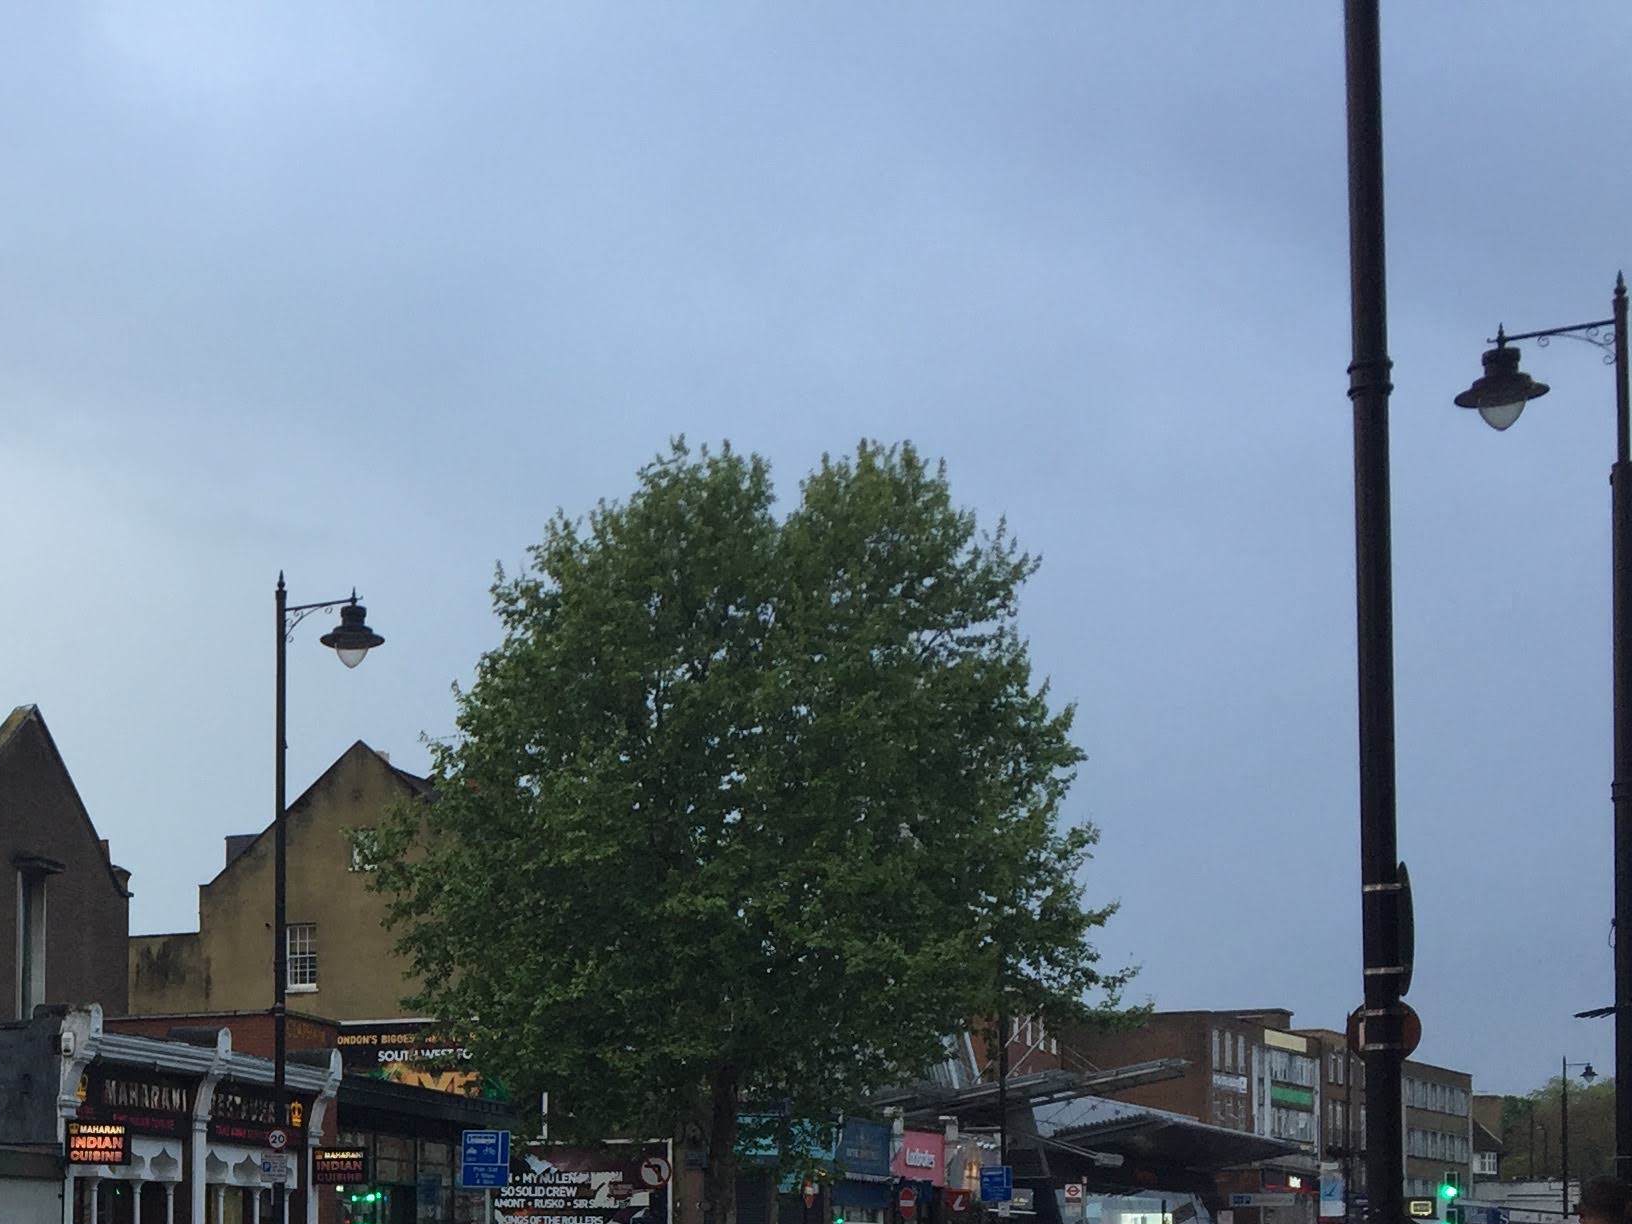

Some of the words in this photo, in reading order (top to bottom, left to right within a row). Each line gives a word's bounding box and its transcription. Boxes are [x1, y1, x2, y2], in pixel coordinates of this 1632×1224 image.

[337, 1035, 378, 1045] ONDON'S
[105, 1079, 187, 1112] MAHARANI
[79, 1124, 125, 1134] MAHARANI
[70, 1136, 124, 1149] INDIAN
[270, 1134, 285, 1144] 20
[69, 1150, 124, 1162] CUISINE
[324, 1151, 364, 1159] MAHARANI
[316, 1160, 362, 1171] INDIAN
[523, 1172, 537, 1183] MY
[500, 1186, 515, 1197] SO
[515, 1186, 545, 1197] SOLID
[546, 1186, 578, 1197] CREW
[494, 1198, 526, 1208] AMONT
[534, 1198, 565, 1208] RUSKO
[572, 1199, 589, 1209] SIR
[541, 1215, 561, 1224] THE
[561, 1215, 604, 1224] ROLLERS
